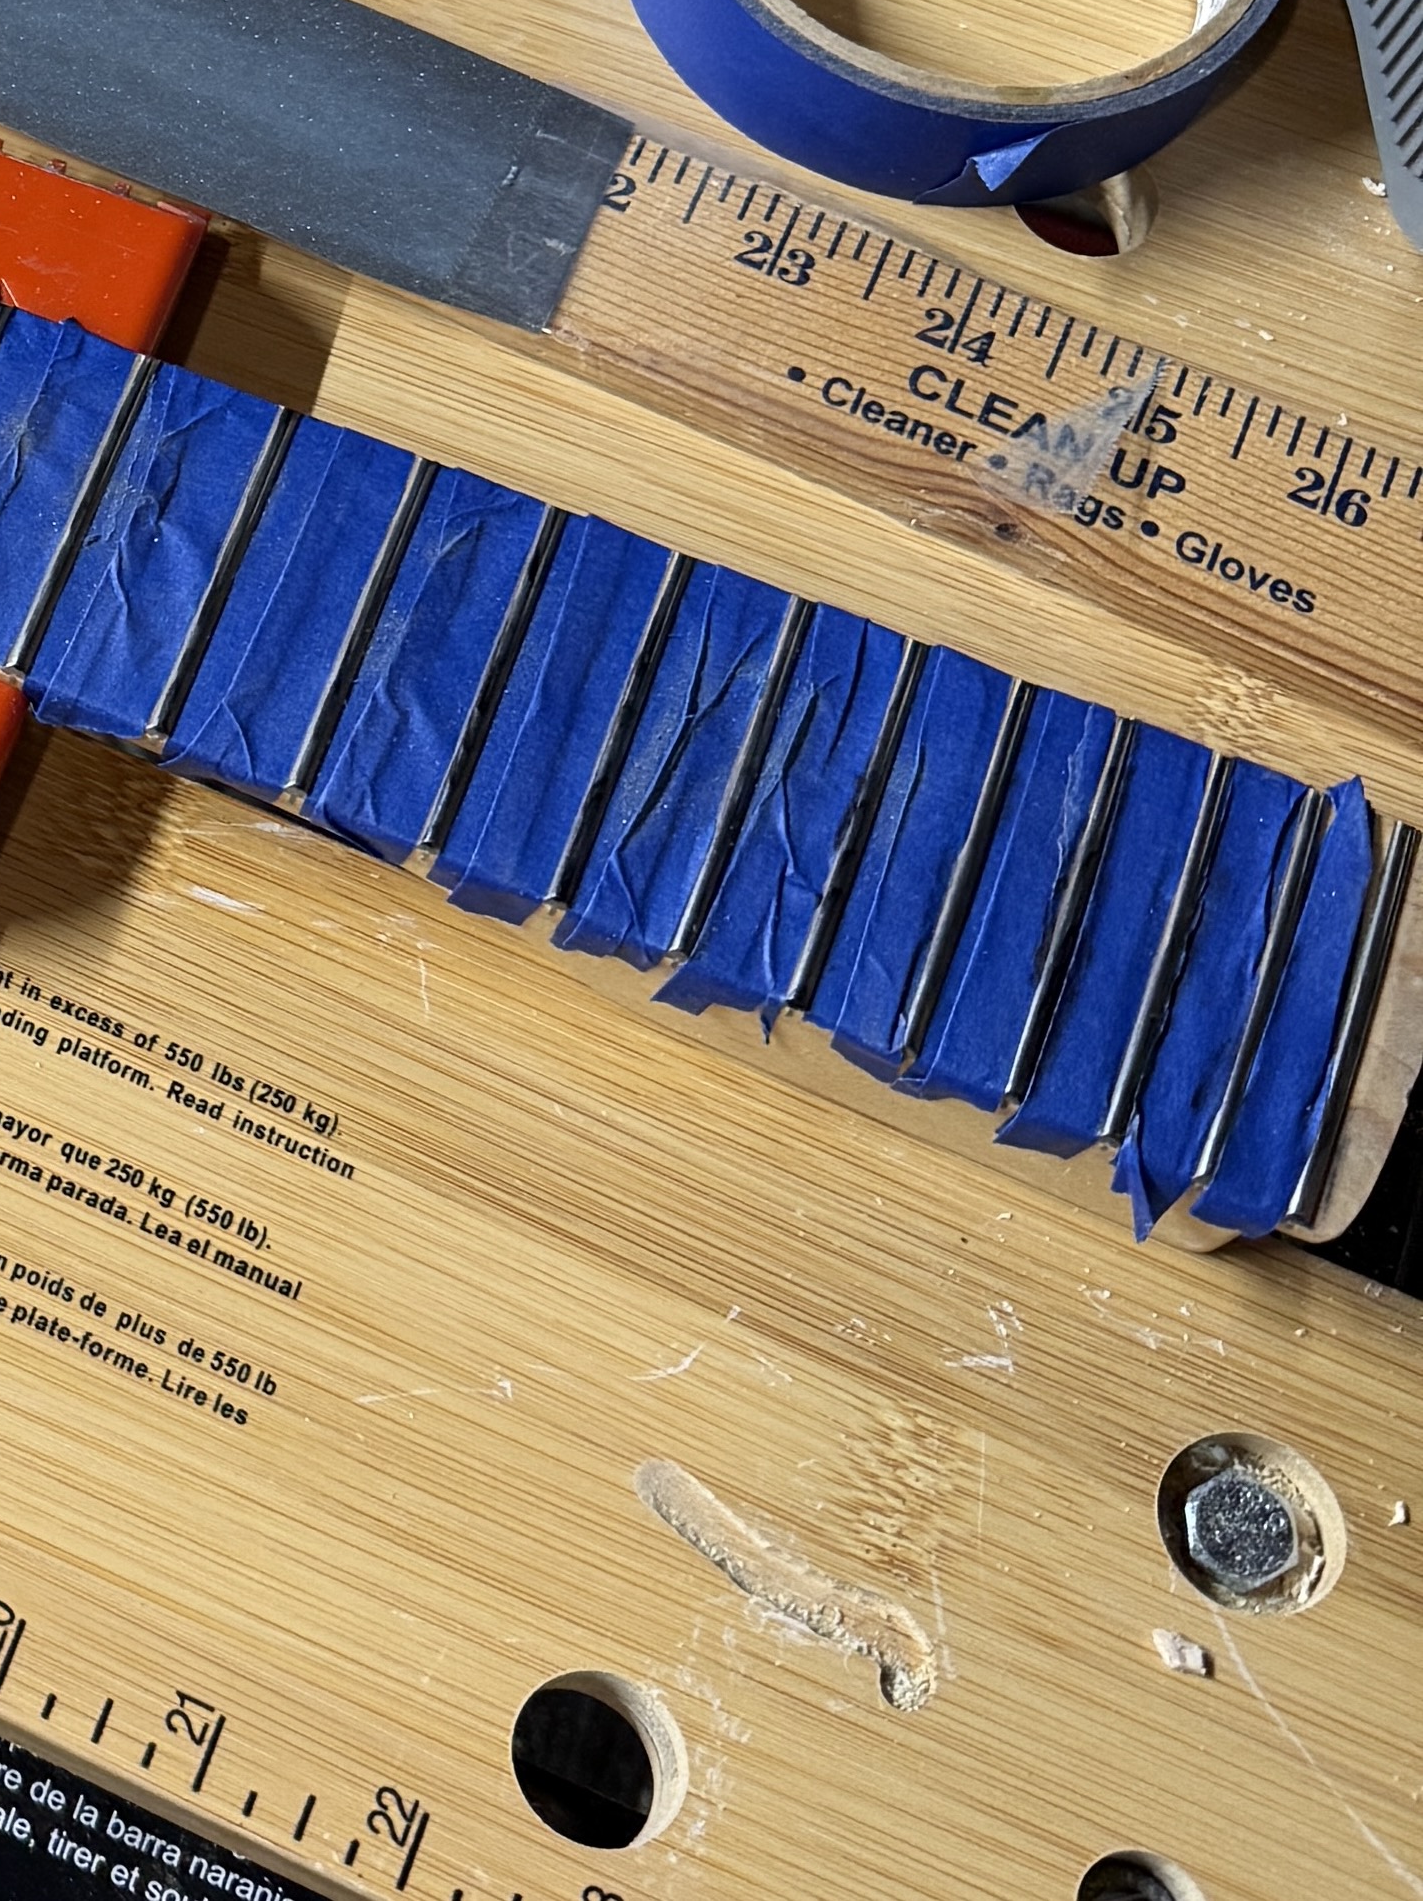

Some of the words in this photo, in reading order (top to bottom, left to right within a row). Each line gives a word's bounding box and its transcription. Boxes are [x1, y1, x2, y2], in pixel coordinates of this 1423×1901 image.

[735, 230, 816, 289] 23
[916, 305, 999, 369] 24
[1288, 465, 1370, 530] 26
[821, 377, 978, 465] Cleaner
[1175, 530, 1317, 615] Gloves
[1109, 446, 1188, 500] UP
[19, 976, 43, 1002] in
[47, 994, 127, 1040] excess
[130, 1032, 161, 1053] of
[163, 1041, 204, 1073] 550
[210, 1061, 246, 1092] lbs
[243, 1079, 298, 1122] (250
[295, 1100, 342, 1142] kg).
[57, 1035, 158, 1092] platform.
[165, 1079, 226, 1121] Read
[231, 1109, 356, 1181] instruction
[44, 1172, 133, 1225] parada.
[138, 1211, 183, 1248] Lea
[185, 1237, 212, 1260] el
[211, 1248, 303, 1301] manual
[60, 1141, 102, 1171] que
[103, 1157, 145, 1189] 250
[146, 1176, 178, 1209] kg
[183, 1194, 235, 1231] (550
[235, 1216, 271, 1251] lb).
[8, 1262, 76, 1303] poids
[78, 1291, 107, 1318] de
[113, 1311, 167, 1346] plus
[176, 1337, 206, 1363] de
[209, 1350, 252, 1384] 550
[253, 1369, 277, 1396] lb
[9, 1303, 154, 1383] plate-forme.
[160, 1368, 209, 1407] Lire
[211, 1392, 249, 1426] les
[29, 1778, 66, 1811] de
[72, 1794, 99, 1829] la
[105, 1809, 181, 1868] barra
[47, 1827, 106, 1873] tirer
[110, 1863, 140, 1893] et
[366, 1785, 420, 1848] 22
